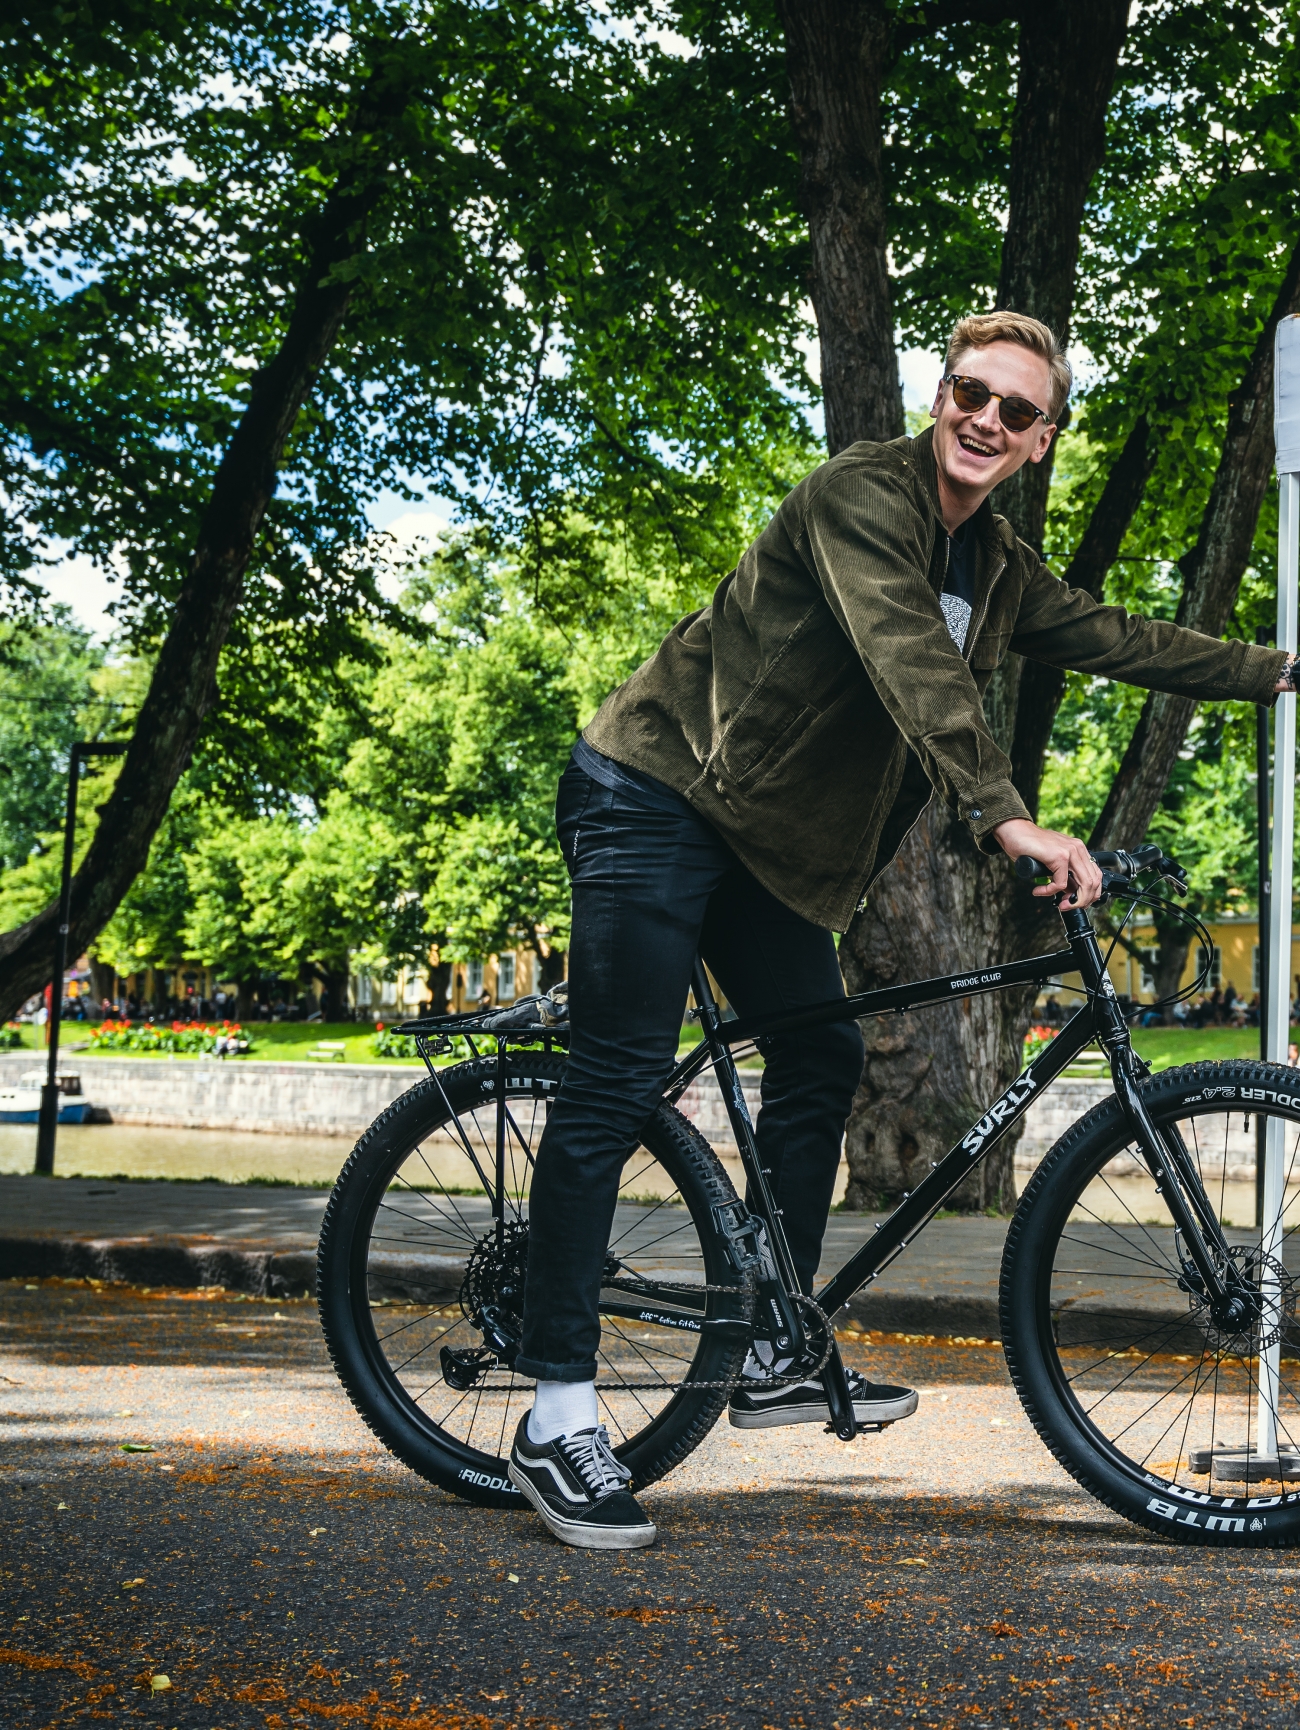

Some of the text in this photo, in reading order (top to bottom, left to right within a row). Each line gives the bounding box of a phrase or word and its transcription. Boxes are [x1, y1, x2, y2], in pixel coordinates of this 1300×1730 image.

[950, 972, 1002, 989] BRIDGE CLUB
[505, 1078, 558, 1090] WT
[1202, 1086, 1236, 1100] 2.4
[962, 1068, 1036, 1156] SURLY
[460, 1468, 521, 1493] RIDDLE
[1146, 1498, 1246, 1532] WTB
